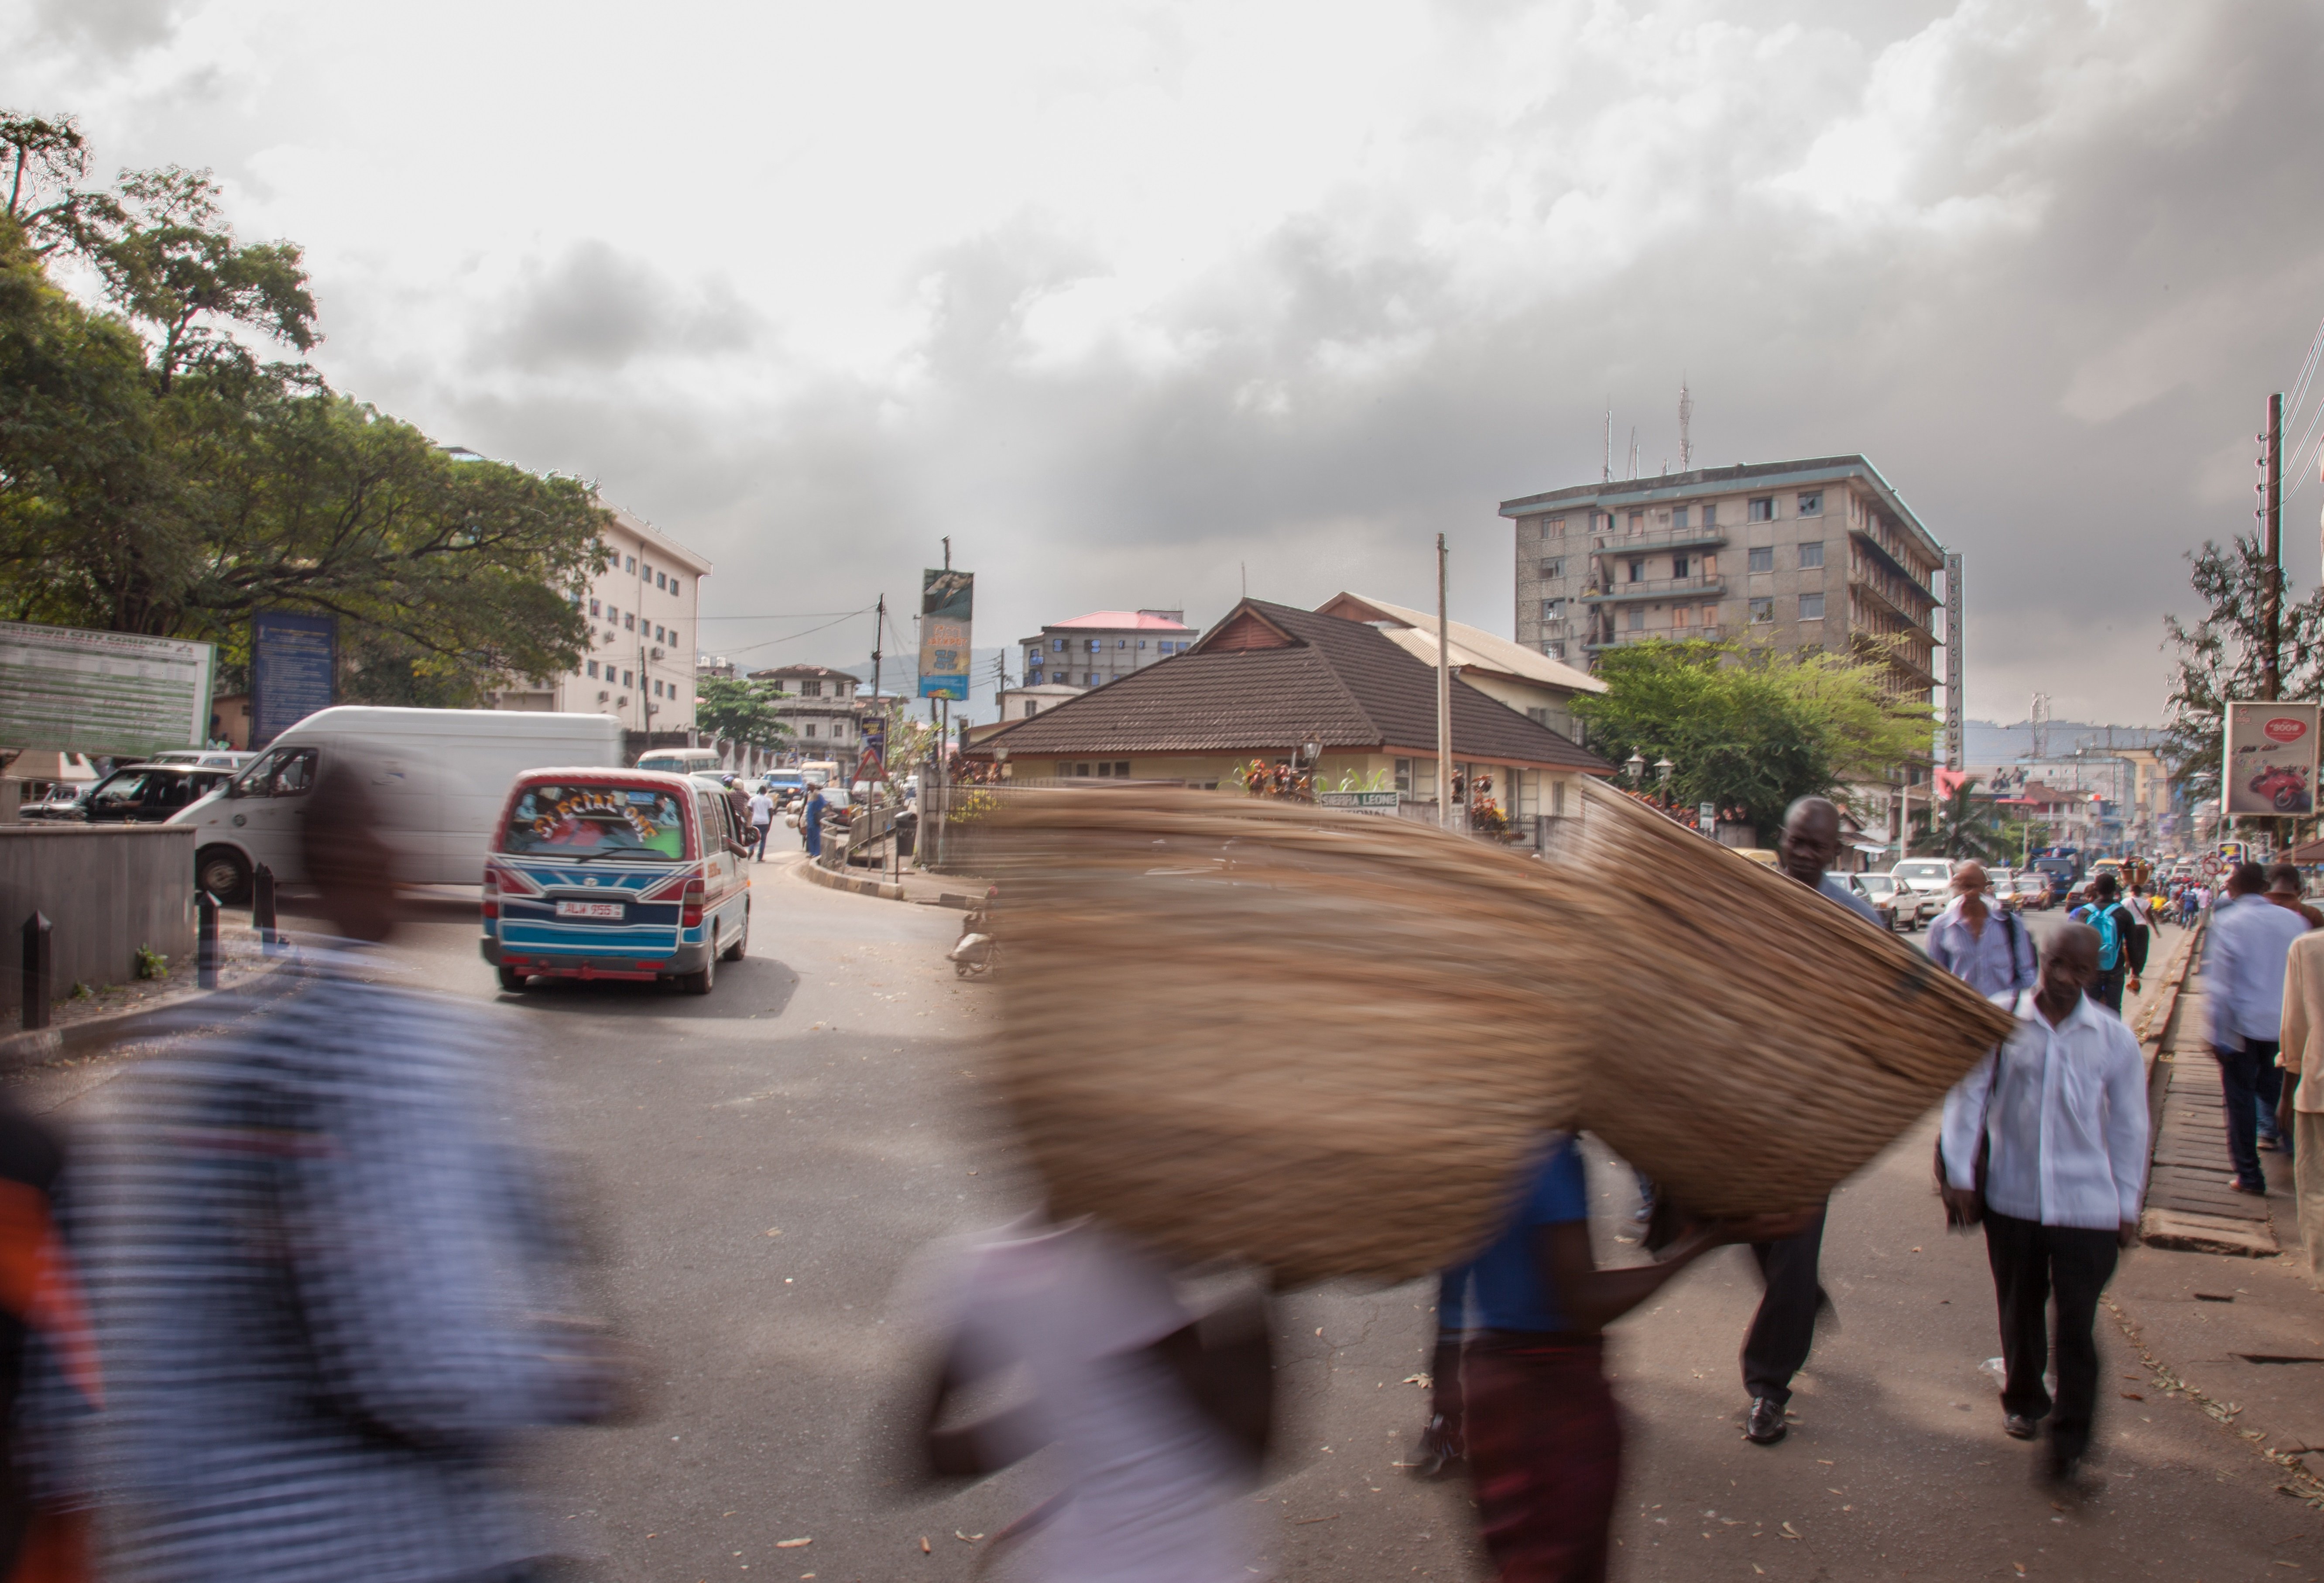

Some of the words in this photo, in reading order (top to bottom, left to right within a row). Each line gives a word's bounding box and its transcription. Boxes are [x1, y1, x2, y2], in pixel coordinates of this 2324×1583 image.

[1948, 559, 1959, 695] ELECTRICITY
[69, 631, 104, 640] CITY
[106, 635, 173, 647] COUNCIL
[1949, 707, 1959, 766] HOUSE
[1321, 794, 1361, 806] SIERRA
[1362, 793, 1396, 806] LEONE
[592, 905, 612, 915] 955
